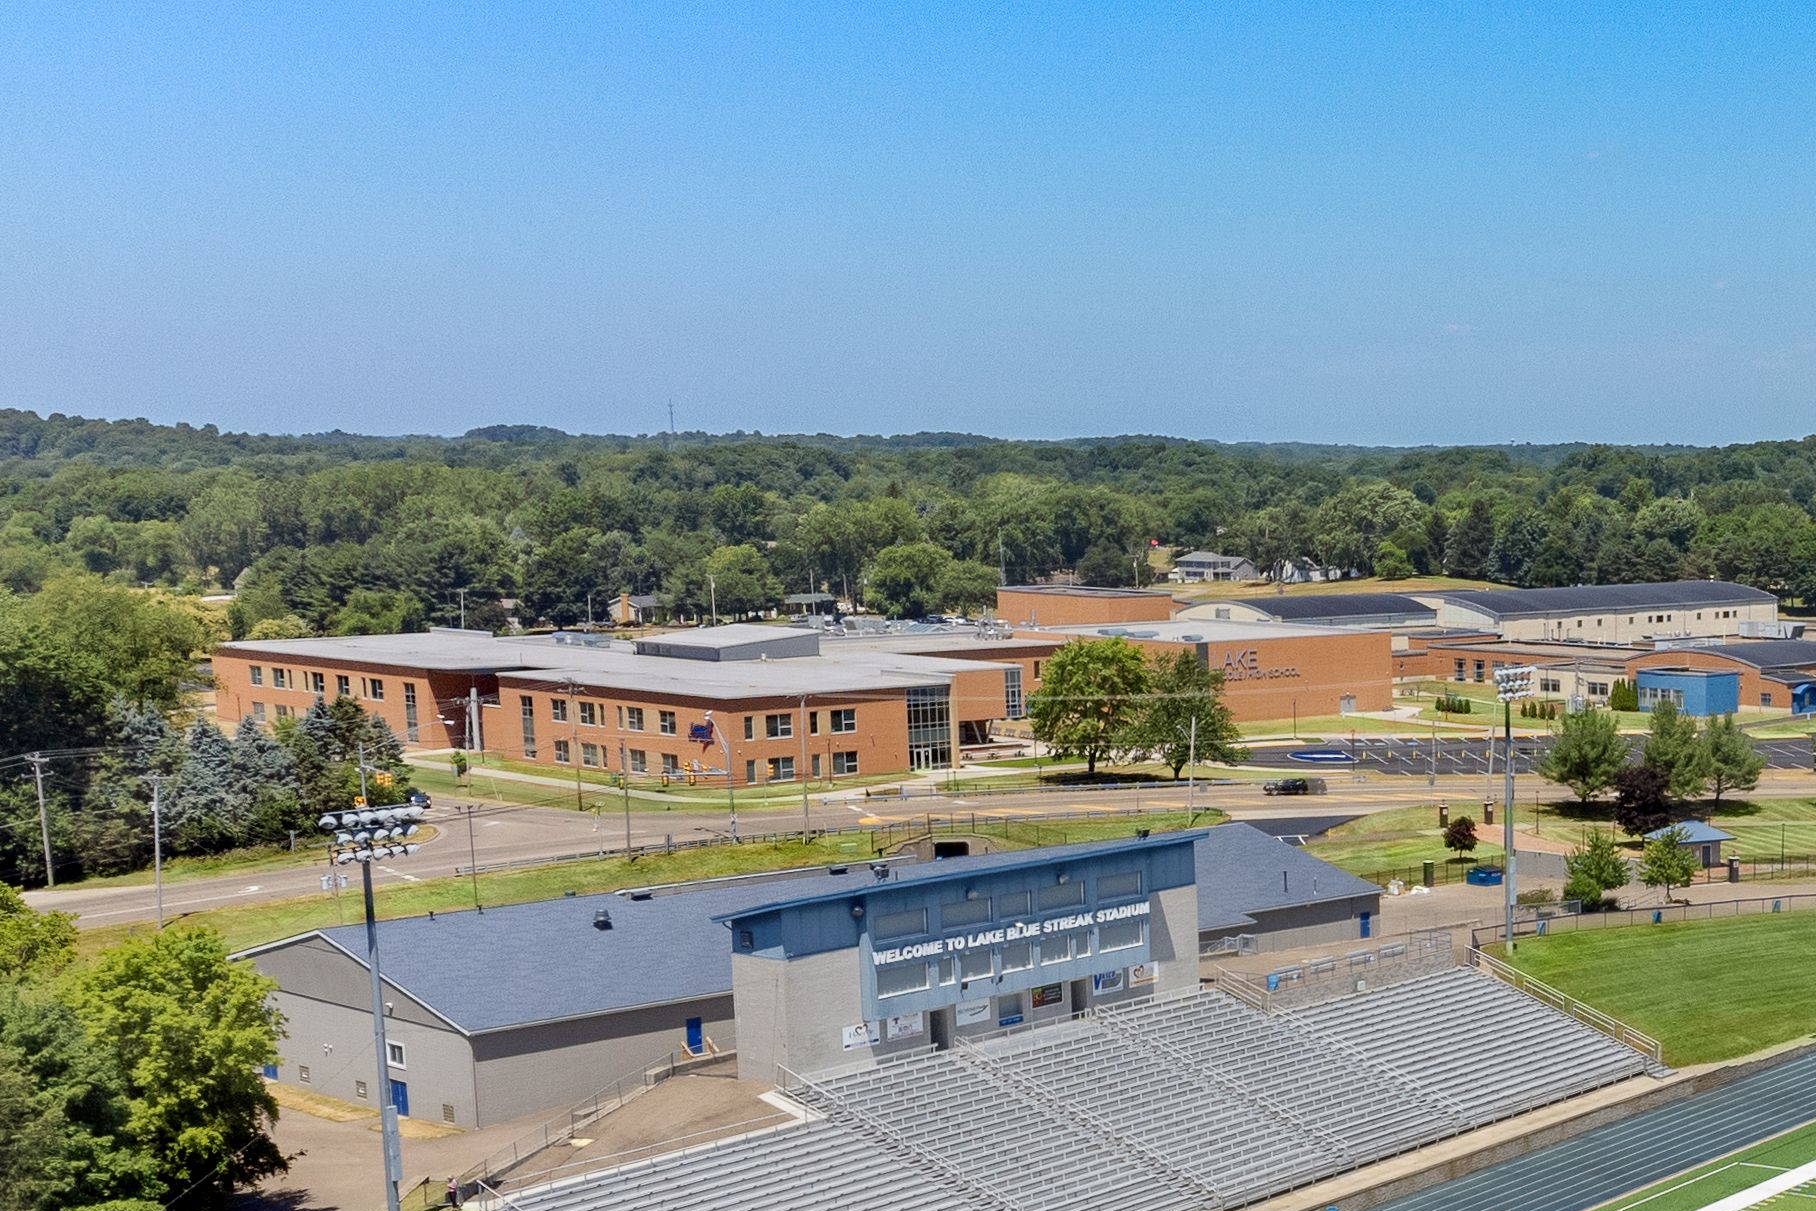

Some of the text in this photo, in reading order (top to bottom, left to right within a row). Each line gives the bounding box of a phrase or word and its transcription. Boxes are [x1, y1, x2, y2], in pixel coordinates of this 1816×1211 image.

[1212, 648, 1257, 670] LAKE
[1268, 667, 1300, 679] SCHOOL
[872, 902, 1150, 966] WELCOME TO LAKE BLUE STREAK STADIUM
